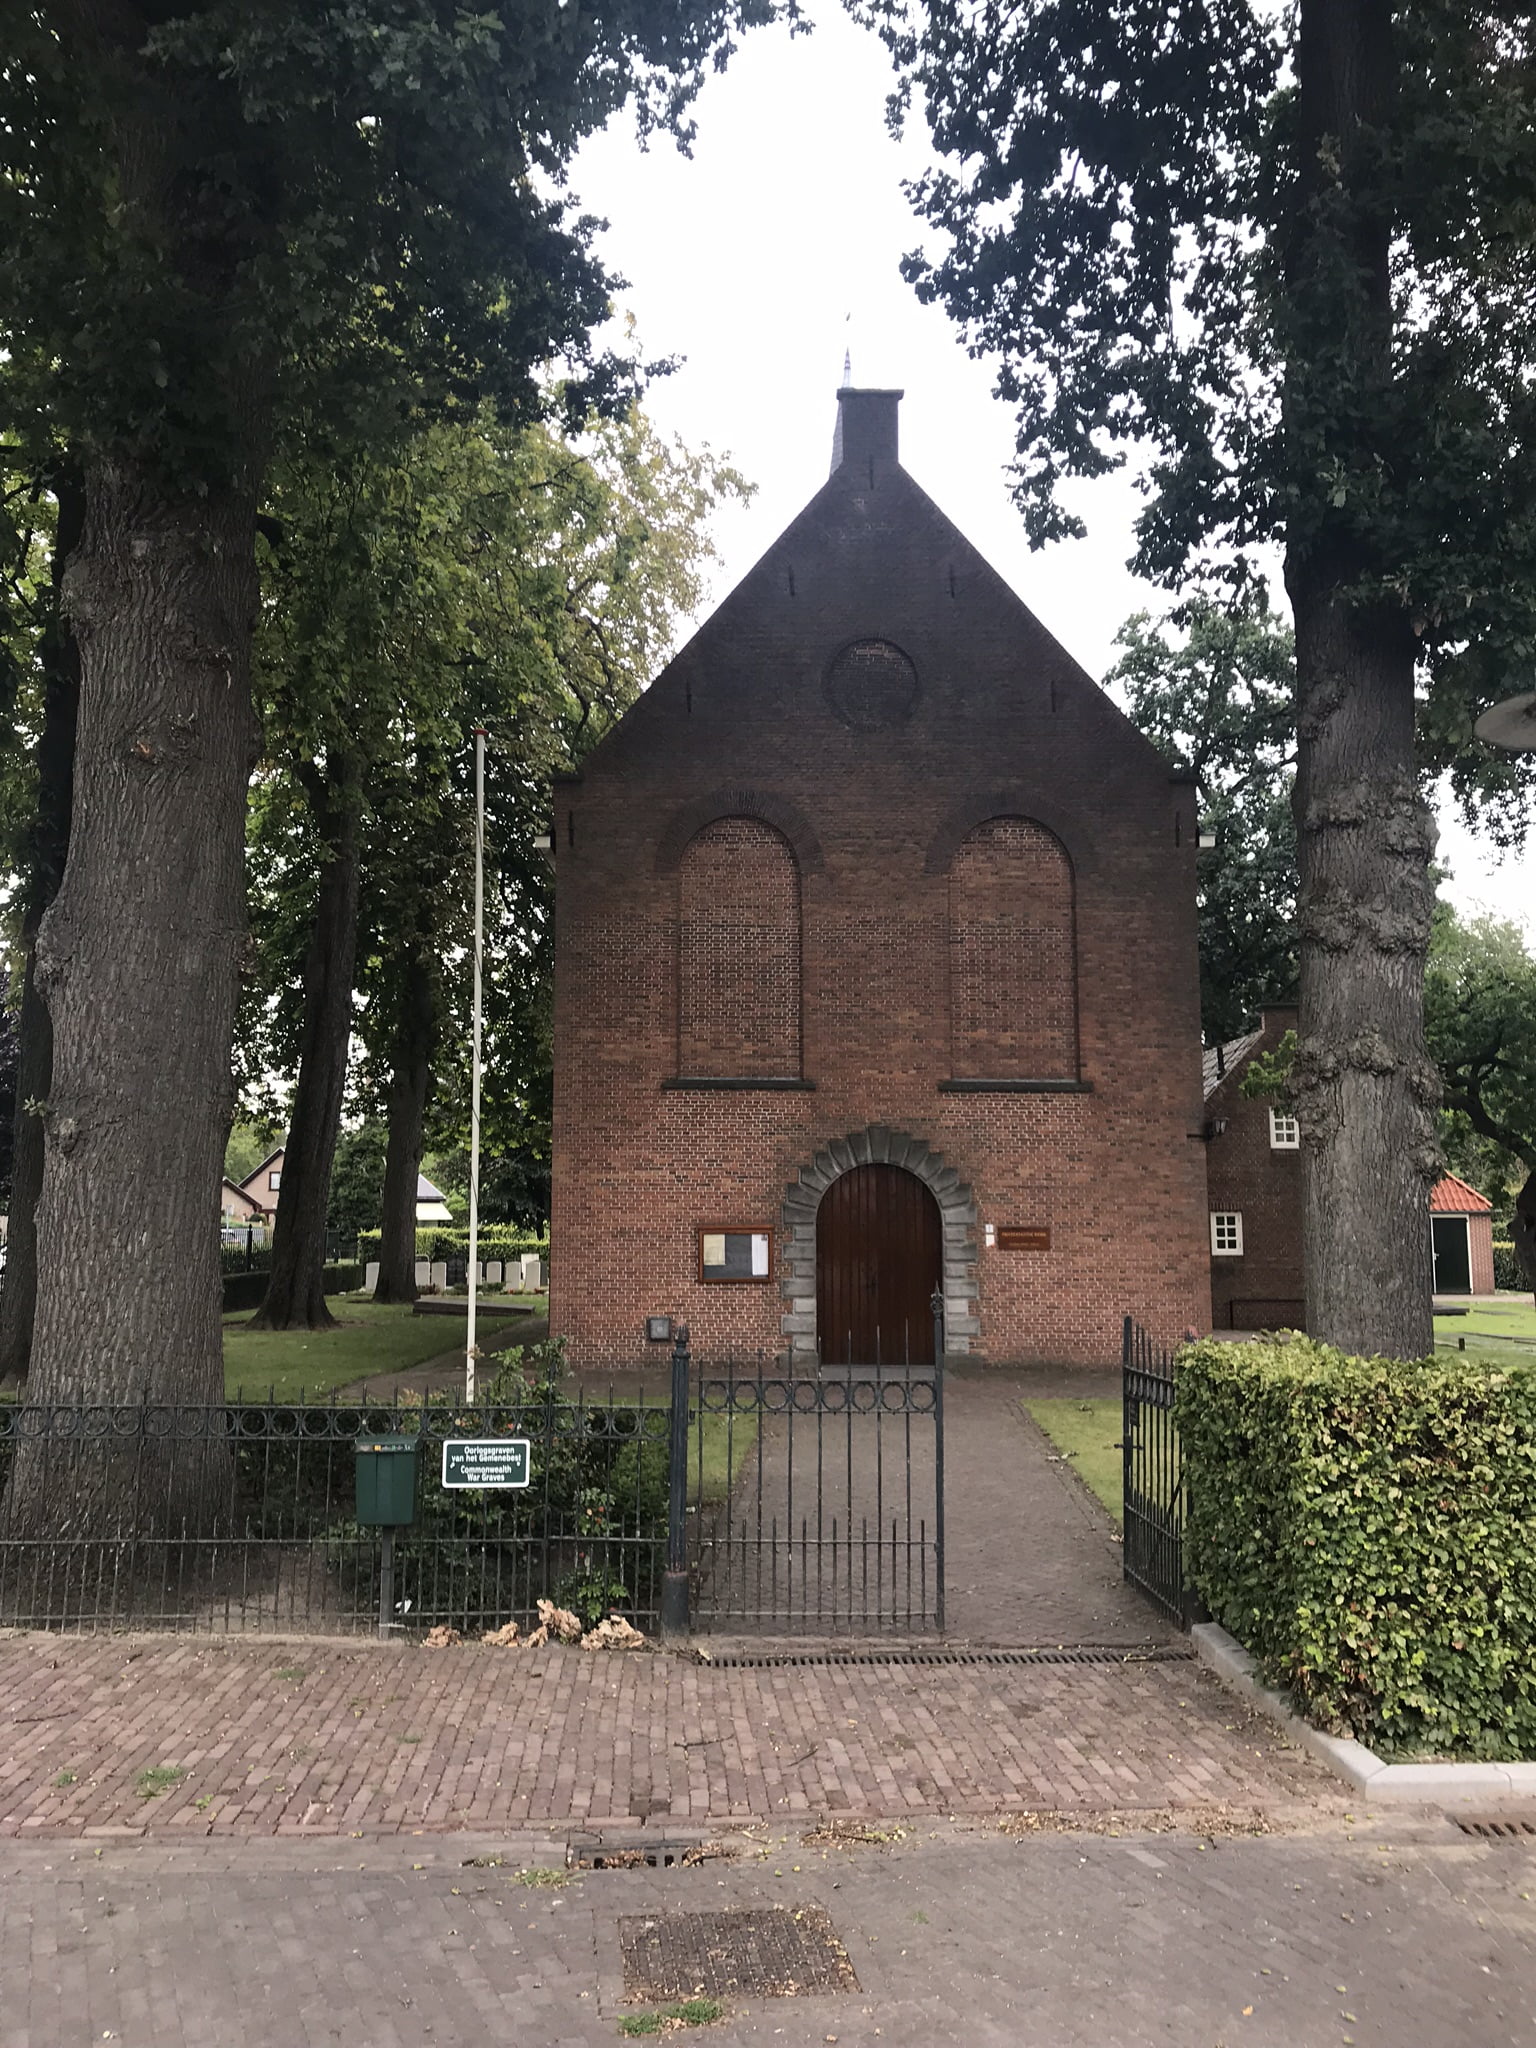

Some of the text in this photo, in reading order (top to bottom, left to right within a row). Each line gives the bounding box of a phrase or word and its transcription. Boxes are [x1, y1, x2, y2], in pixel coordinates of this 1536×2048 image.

[464, 1445, 515, 1455] Oorlogsgraven
[466, 1454, 477, 1462] het
[479, 1453, 522, 1462] Gemenebest
[460, 1465, 512, 1474] Commonwealth
[467, 1473, 505, 1481] War Graves
